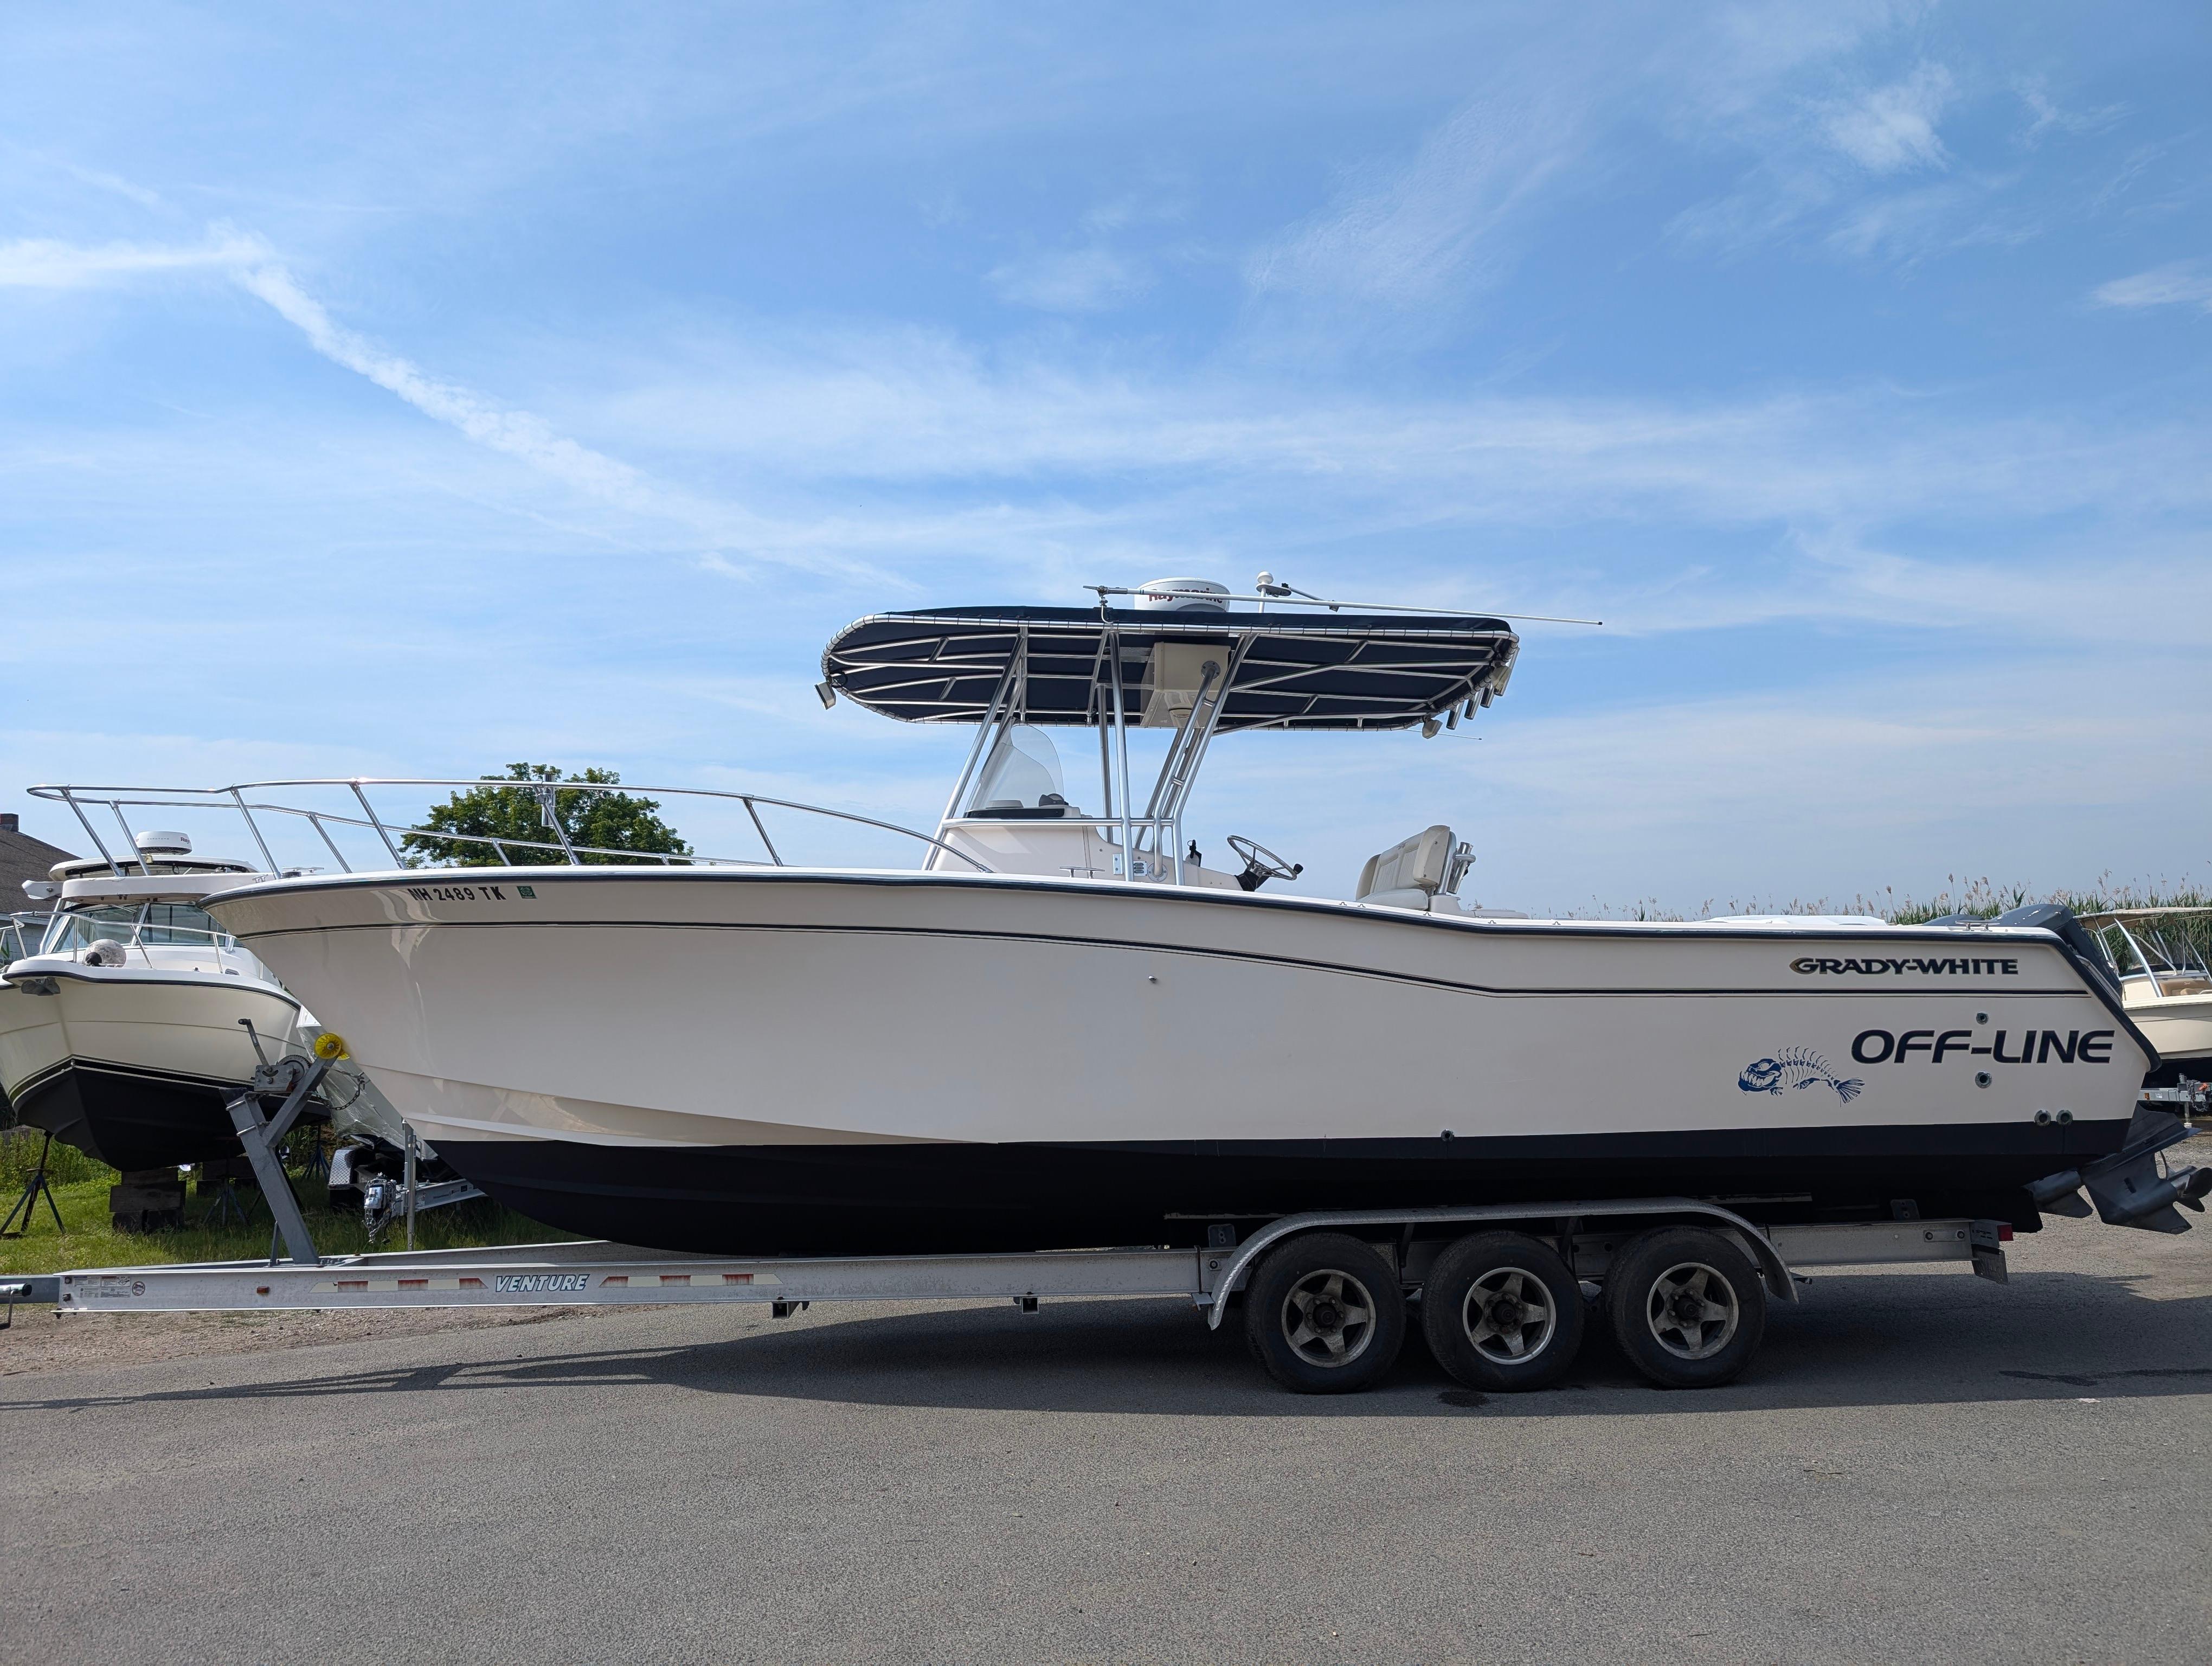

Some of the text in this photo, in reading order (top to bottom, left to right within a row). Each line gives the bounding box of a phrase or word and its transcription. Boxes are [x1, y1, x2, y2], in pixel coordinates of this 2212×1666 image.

[407, 886, 506, 901] NH 2489 TK
[1789, 958, 2018, 975] GRADY-WHITE
[1850, 1029, 2115, 1064] OFF-LINE
[496, 1273, 590, 1293] VENTURE
